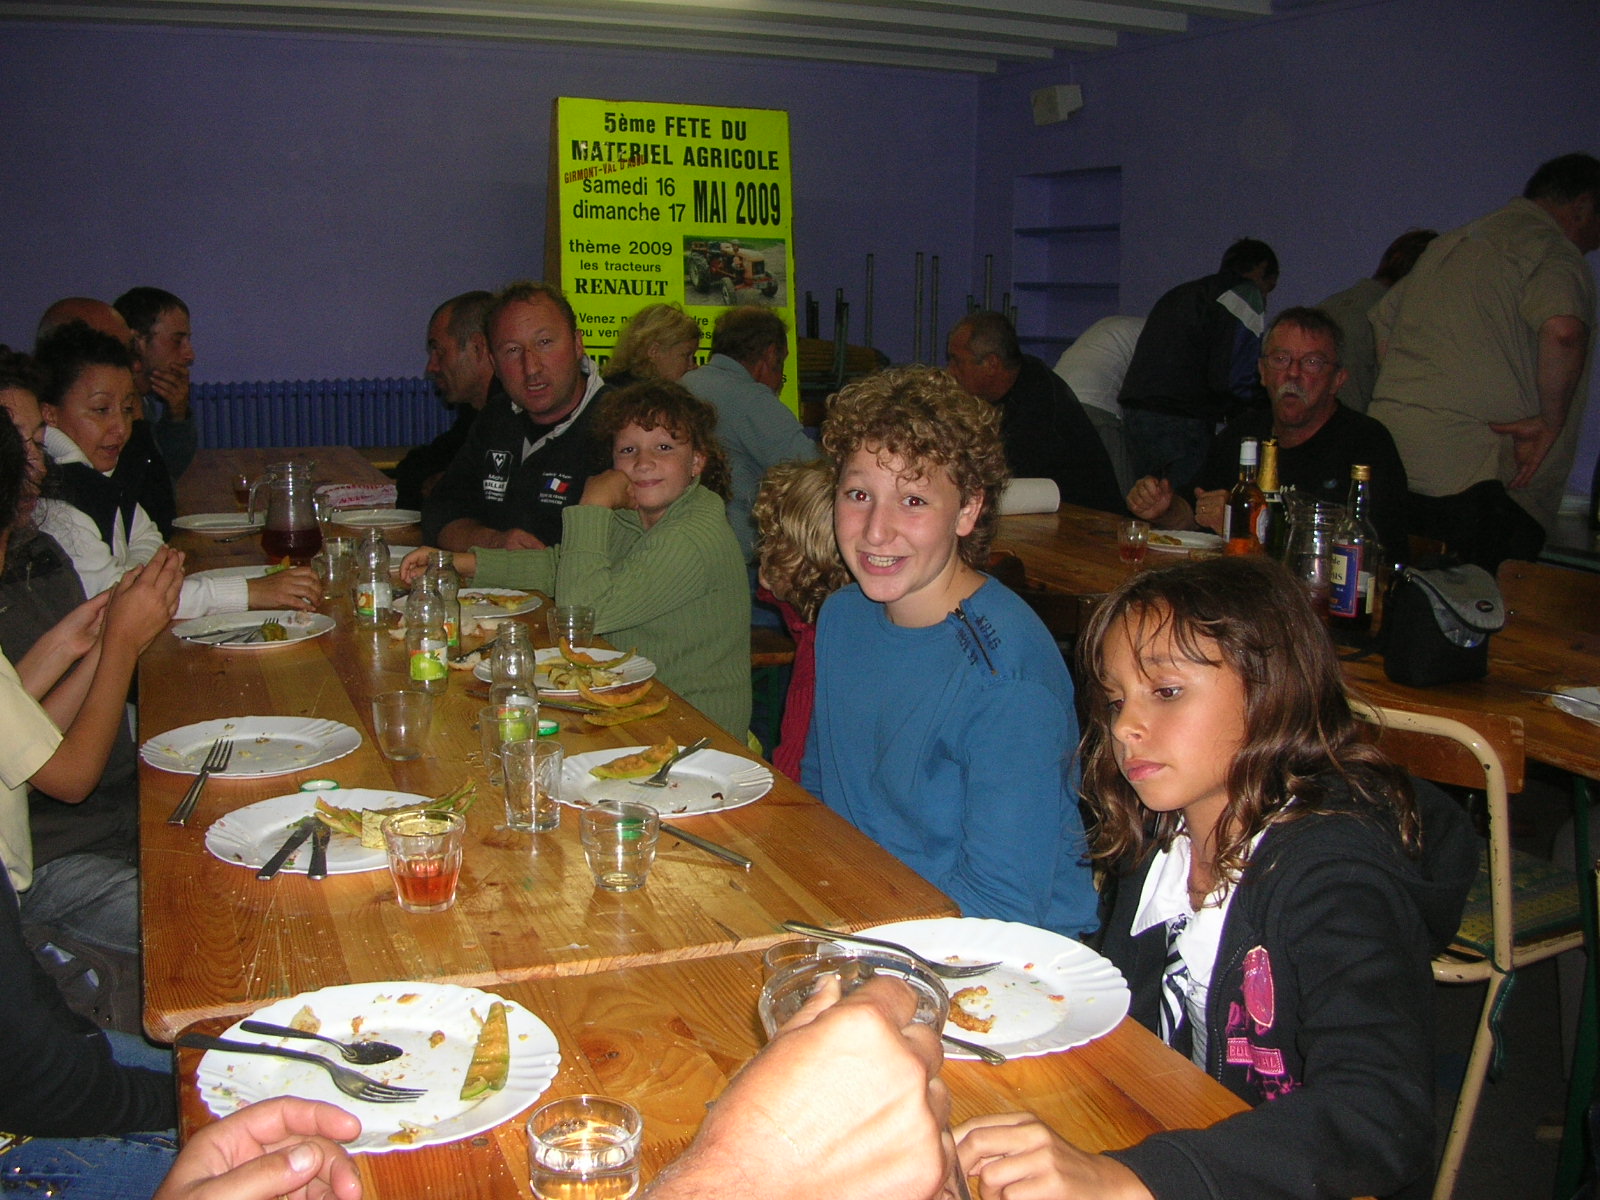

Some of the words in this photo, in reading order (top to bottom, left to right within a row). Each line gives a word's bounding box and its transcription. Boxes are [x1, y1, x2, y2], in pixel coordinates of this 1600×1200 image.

[604, 112, 656, 133] 5ème
[665, 116, 711, 138] FETE
[721, 120, 747, 141] DU
[571, 139, 673, 166] MATERIEL
[683, 146, 779, 171] AGRICOLE
[582, 177, 648, 196] samedi
[656, 178, 675, 197] 16
[573, 200, 660, 222] dimanche
[668, 203, 686, 223] 17
[693, 180, 728, 223] MAI
[735, 181, 781, 226] 2009
[569, 239, 621, 254] thème
[629, 241, 673, 256] 2009
[580, 260, 599, 271] les
[604, 260, 661, 273] tracteurs
[574, 278, 668, 297] RENAULT
[579, 312, 615, 324] Venez
